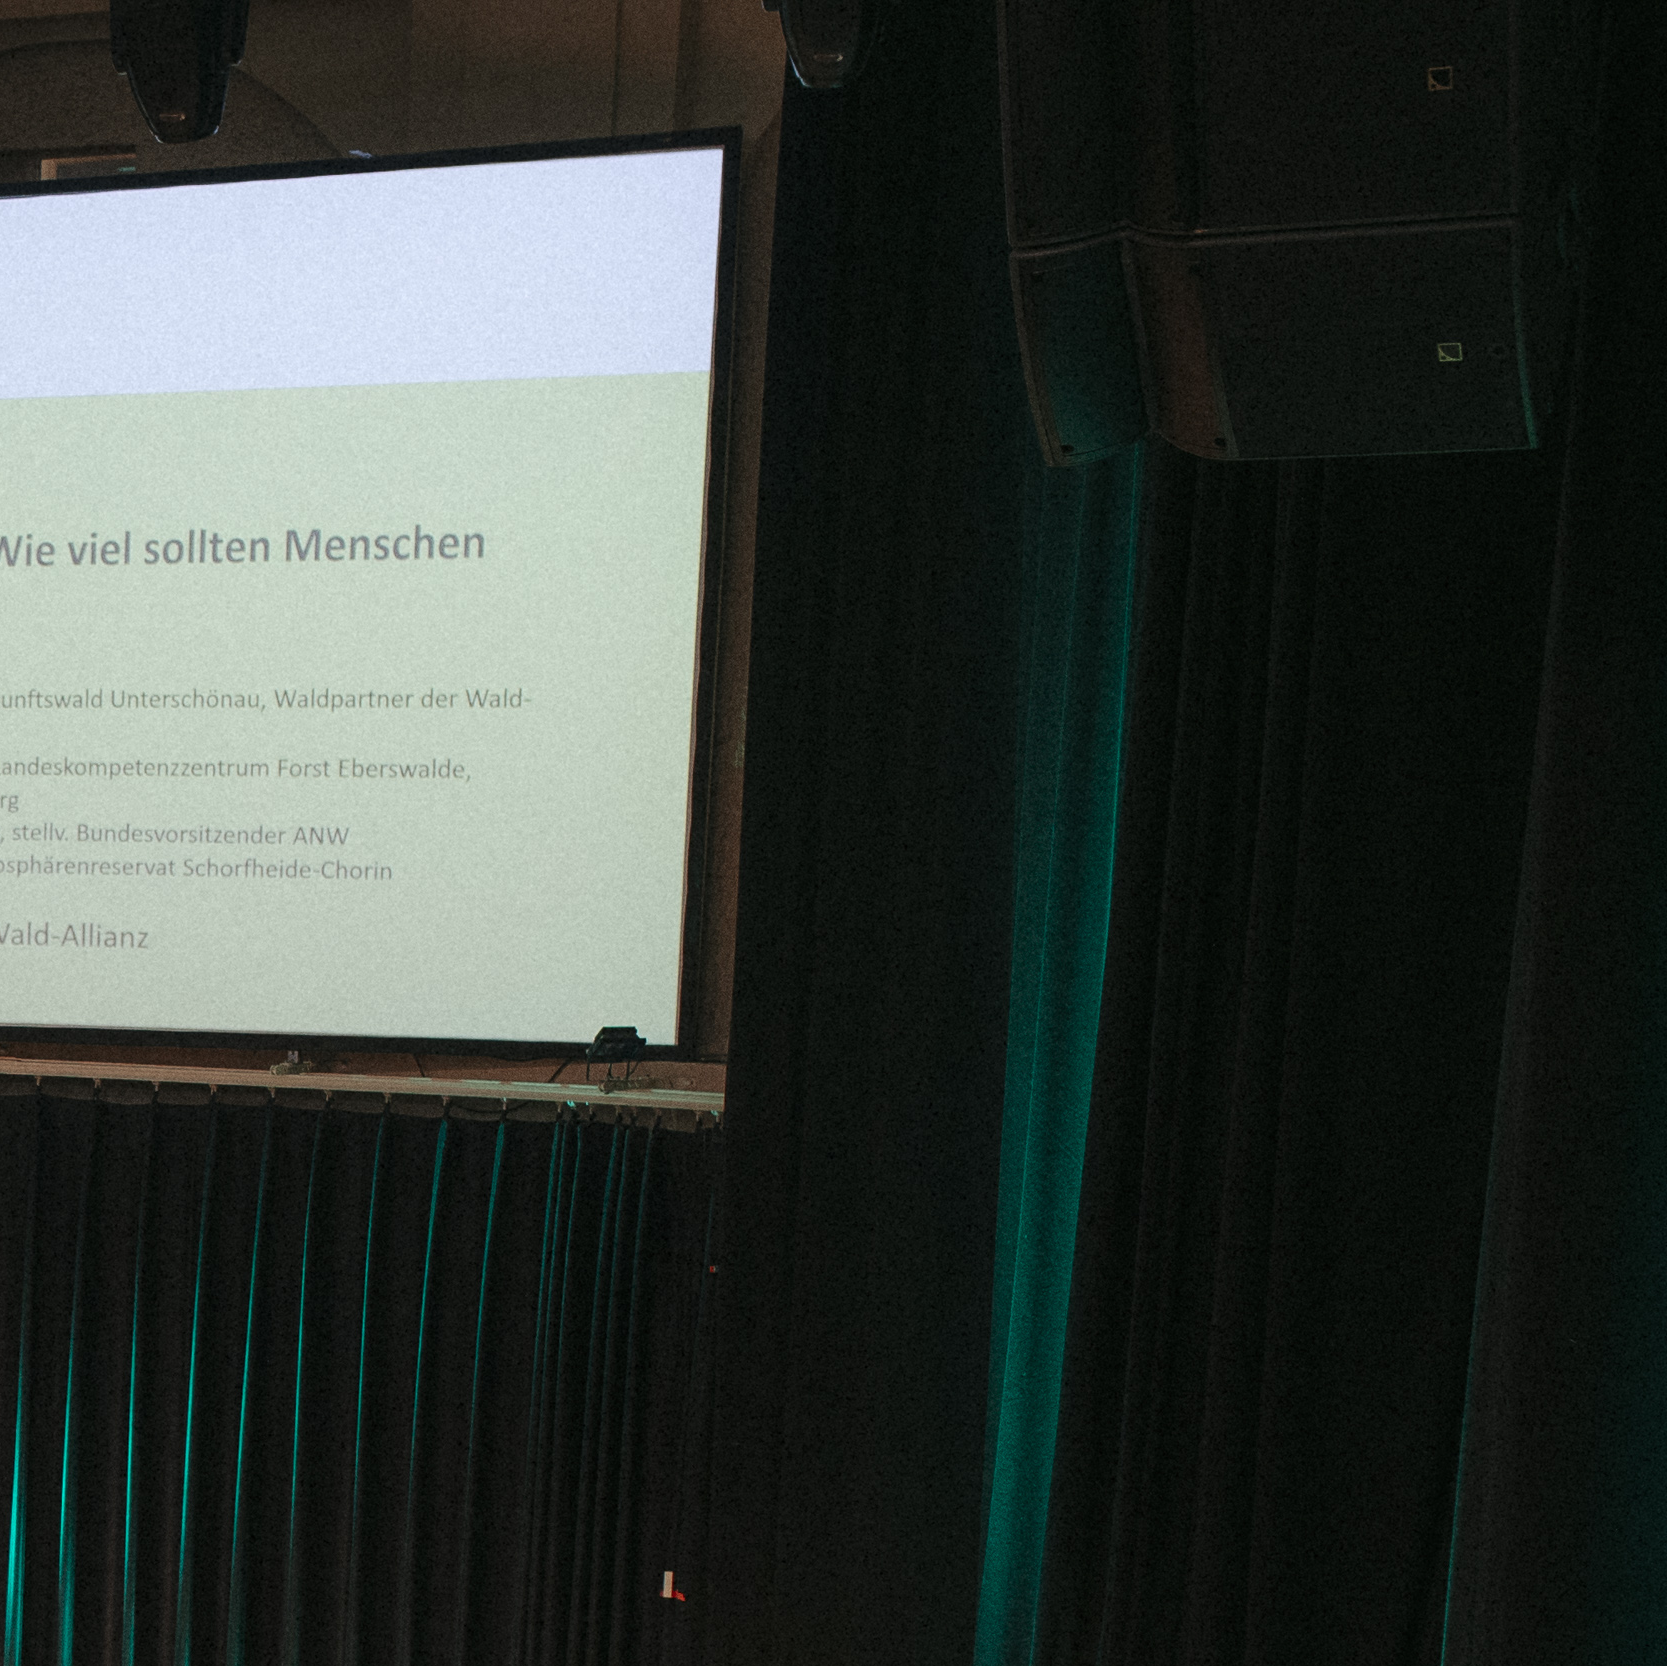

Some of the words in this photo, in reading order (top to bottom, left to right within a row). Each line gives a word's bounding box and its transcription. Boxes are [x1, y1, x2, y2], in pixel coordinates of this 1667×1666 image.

[68, 531, 131, 566] viel
[144, 529, 271, 564] sollten
[285, 525, 486, 562] Menschen
[110, 688, 266, 713] Unterschönau,
[274, 688, 415, 713] Waldpartner
[420, 688, 459, 709] der
[465, 688, 533, 709] Wald-
[278, 758, 331, 778] Forst
[338, 758, 471, 782] Eberswalde,
[12, 822, 68, 842] stellv.
[77, 823, 286, 845] Bundesvorsitzender
[292, 826, 350, 846] ANW
[182, 857, 393, 880] Schorfheide-Chorin
